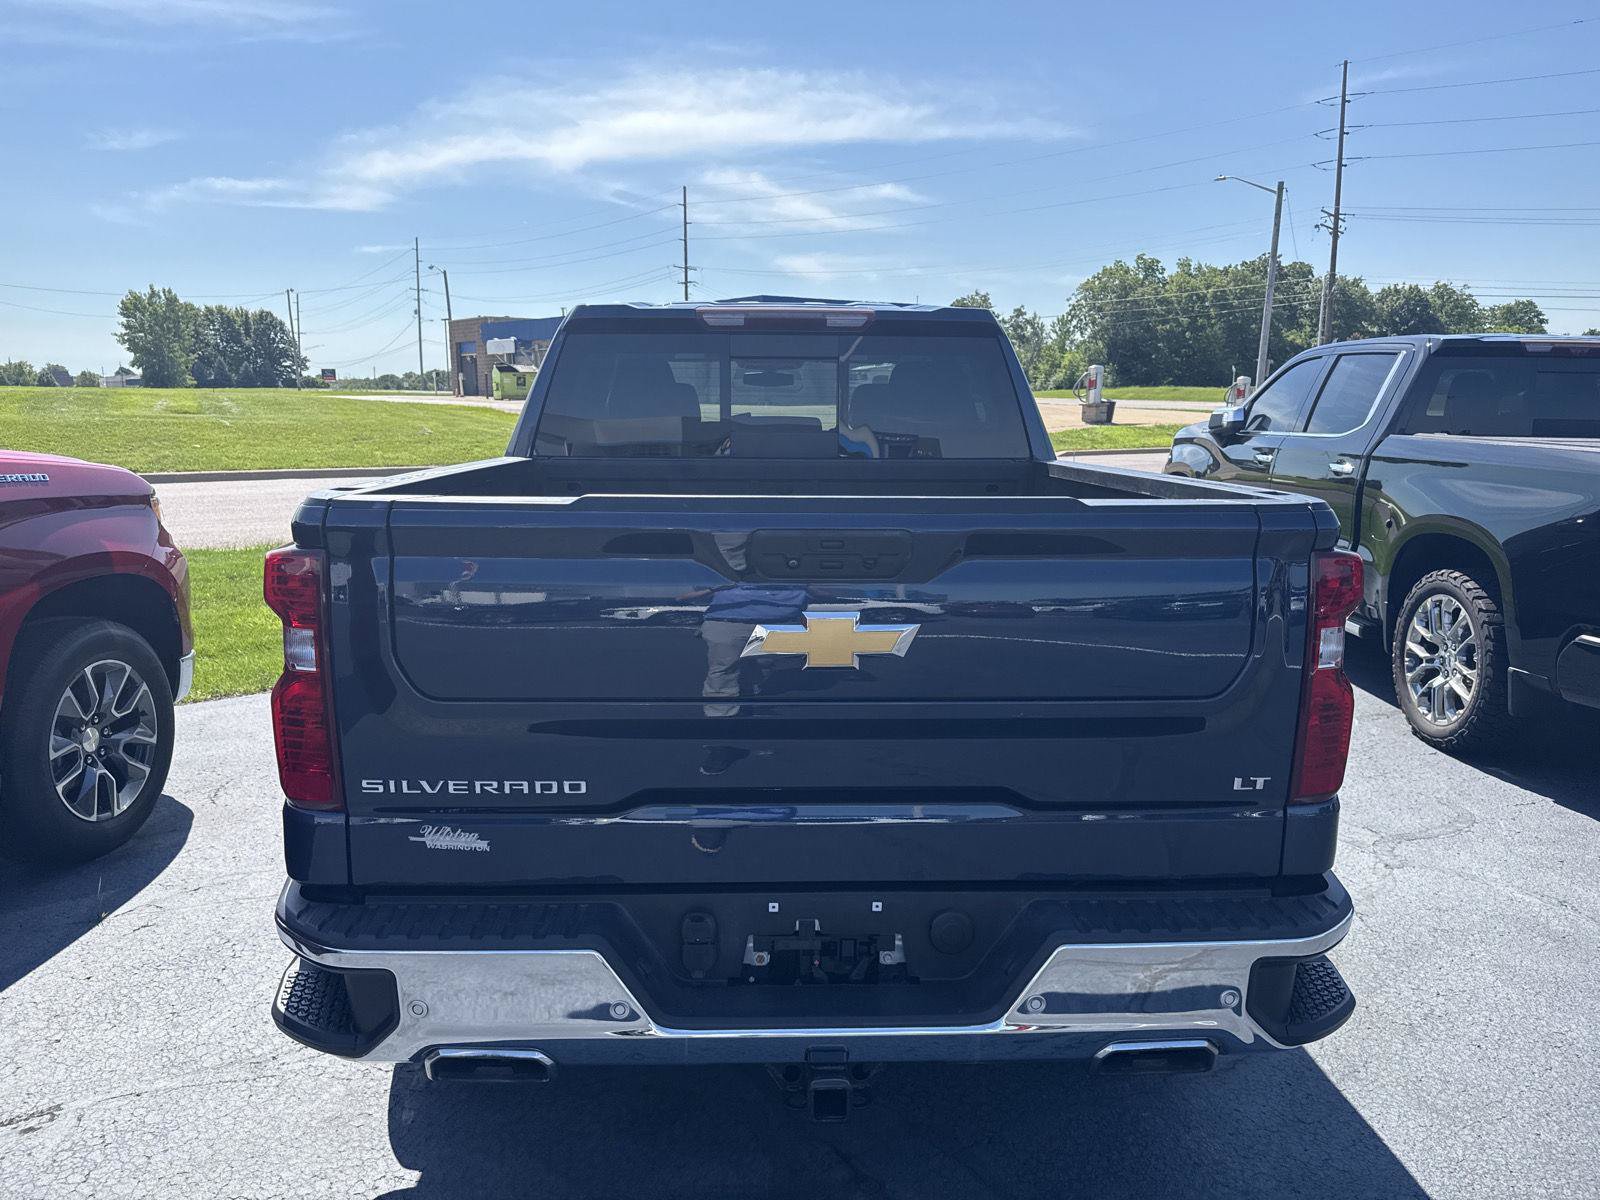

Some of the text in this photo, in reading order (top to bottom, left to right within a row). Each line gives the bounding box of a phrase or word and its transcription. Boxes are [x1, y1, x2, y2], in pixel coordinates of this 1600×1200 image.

[361, 779, 588, 794] SILVERADO
[1233, 776, 1272, 790] LT
[427, 841, 491, 852] WASHINGTON
